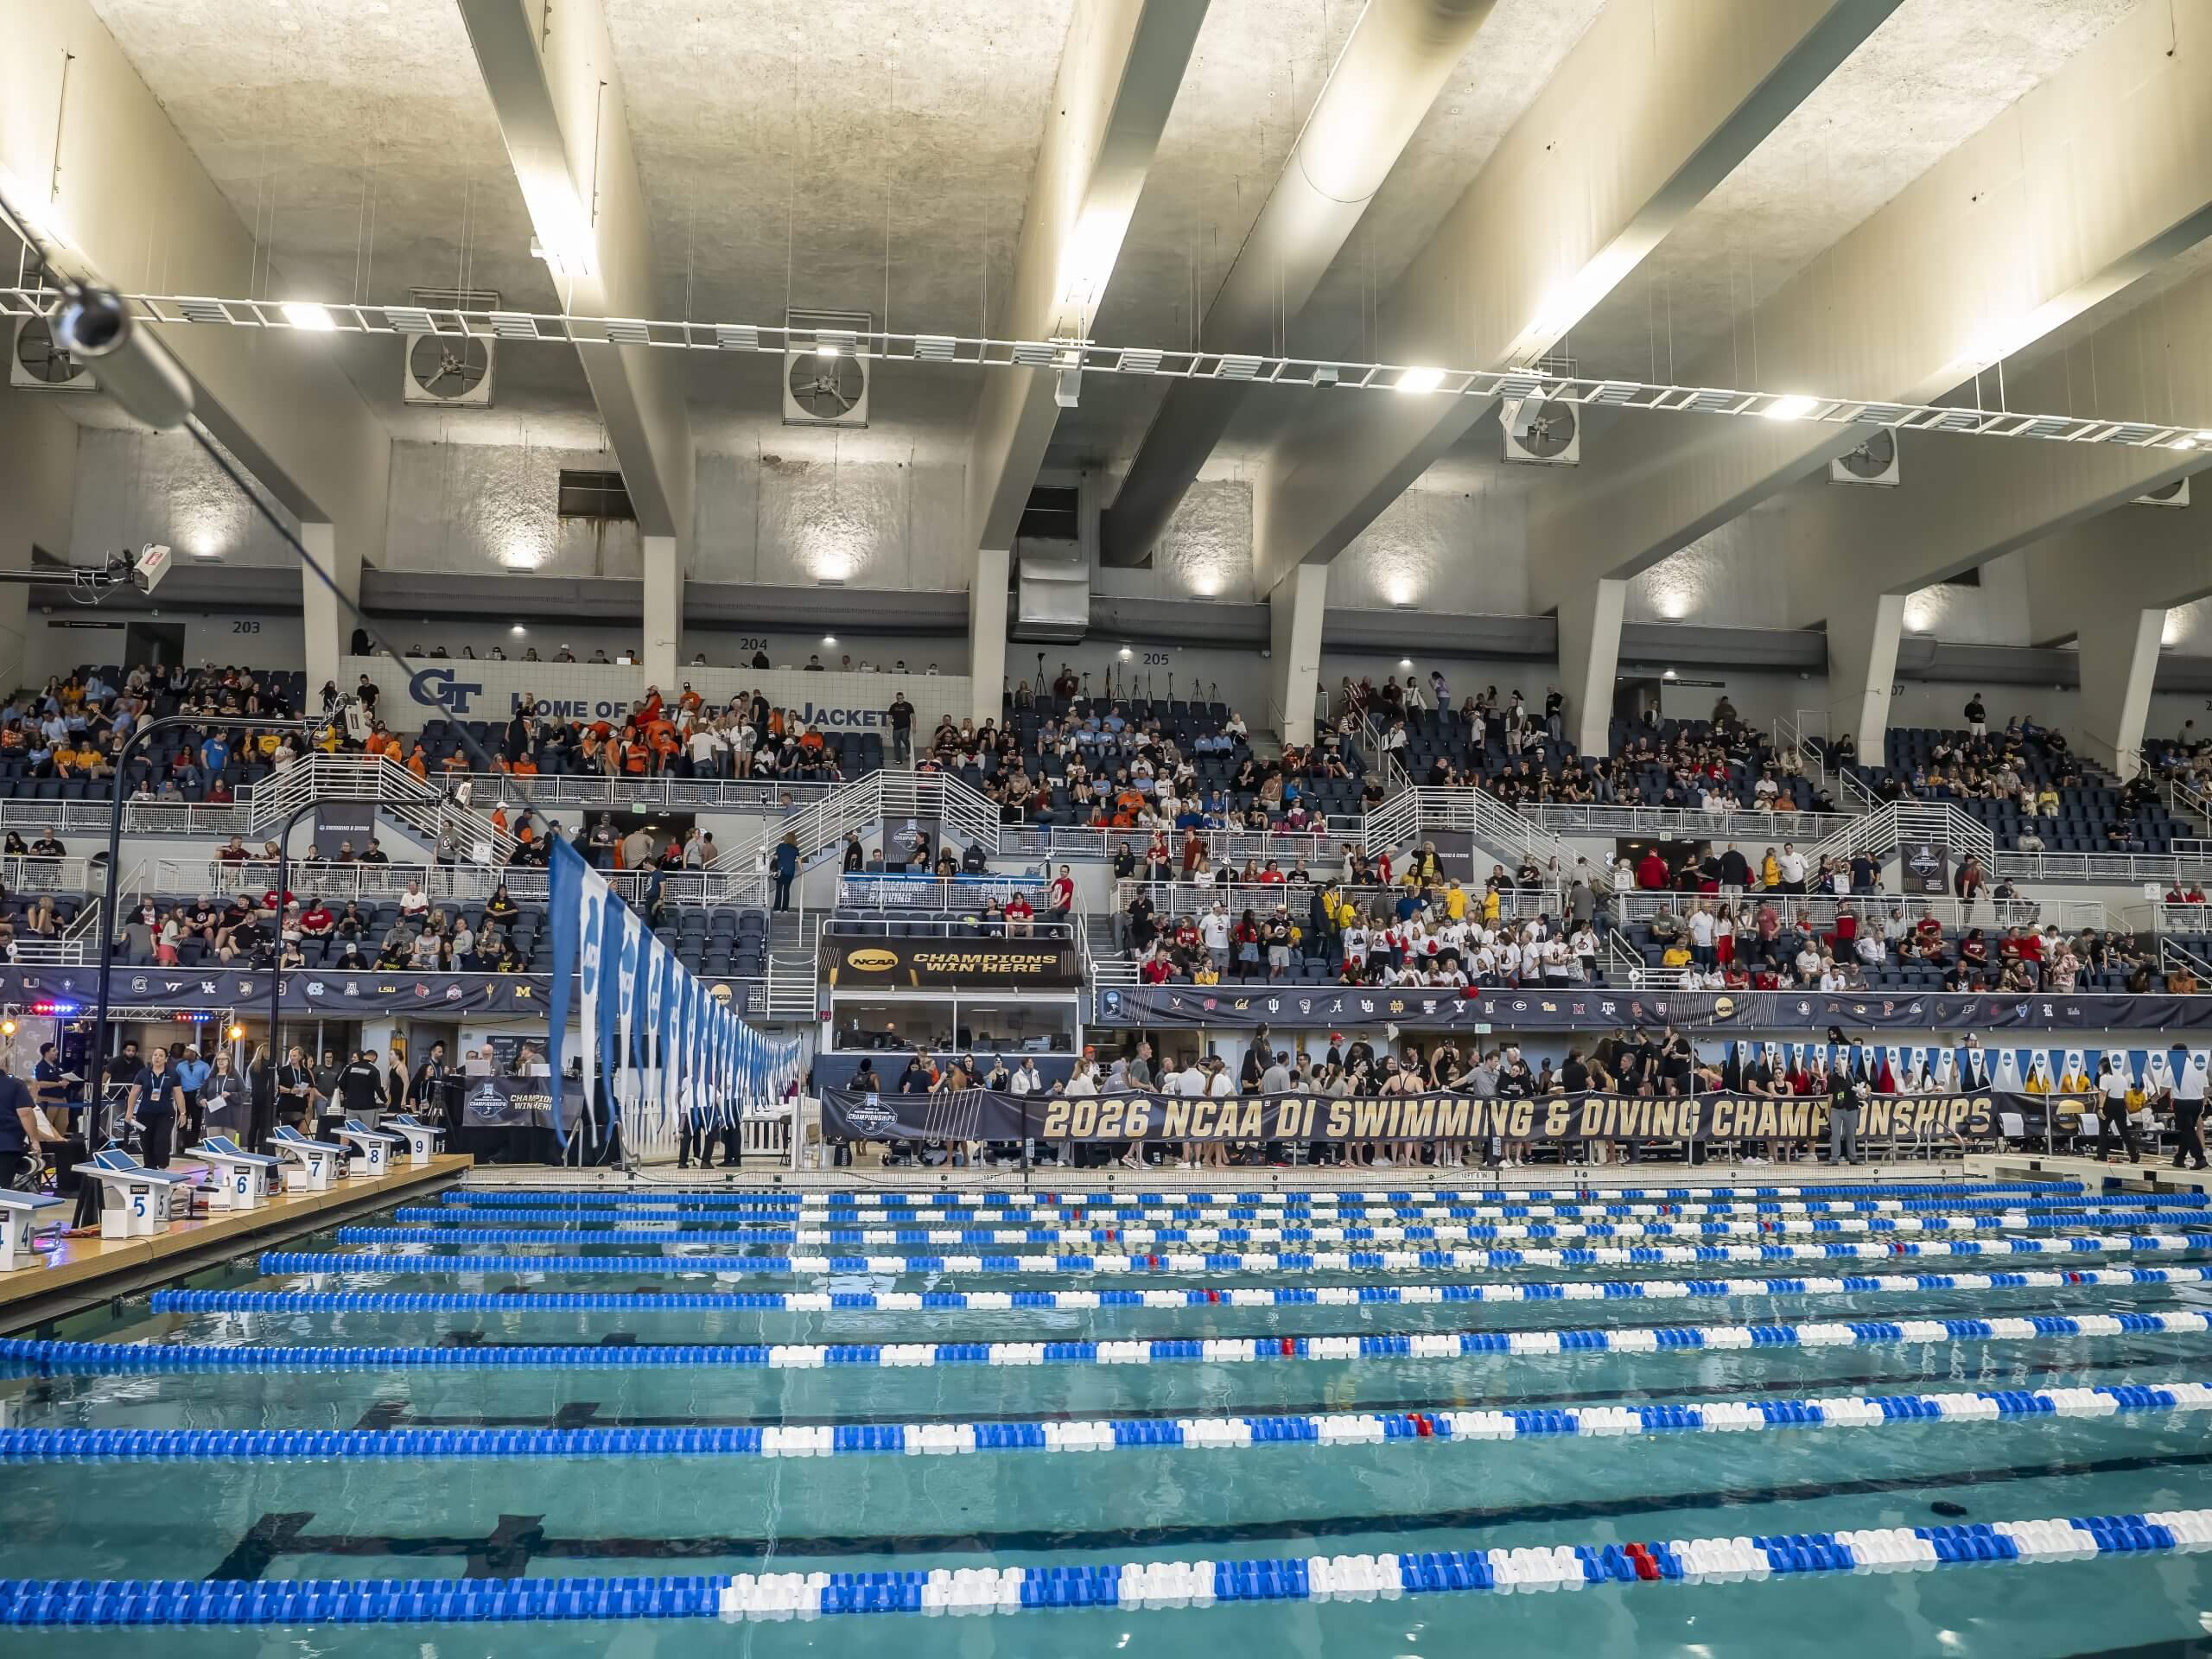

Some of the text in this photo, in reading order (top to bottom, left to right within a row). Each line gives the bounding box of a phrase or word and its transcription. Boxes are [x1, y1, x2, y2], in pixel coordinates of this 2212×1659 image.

[232, 621, 260, 634] 203
[741, 638, 768, 651] 204
[1143, 653, 1169, 665] 205
[1891, 685, 1905, 696] 07
[595, 701, 628, 719] OF
[912, 953, 1058, 964] CHAMPIONS
[926, 963, 1042, 973] WIN HERE
[515, 985, 531, 997] M
[1453, 1000, 1466, 1013] Y
[1512, 1001, 1527, 1012] G
[1043, 1100, 1150, 1138] 2026
[1161, 1100, 1263, 1137] NCAA
[1276, 1100, 1315, 1137] DI
[1325, 1099, 1535, 1138] SWIMMING
[1543, 1100, 1569, 1136] &
[1580, 1099, 1700, 1137] DIVING
[416, 1140, 423, 1154] 9
[370, 1149, 379, 1164] 8
[311, 1160, 321, 1177] 7
[237, 1175, 248, 1195] 6
[133, 1195, 145, 1217] 5
[158, 1194, 164, 1217] 5
[21, 1222, 29, 1247] 4
